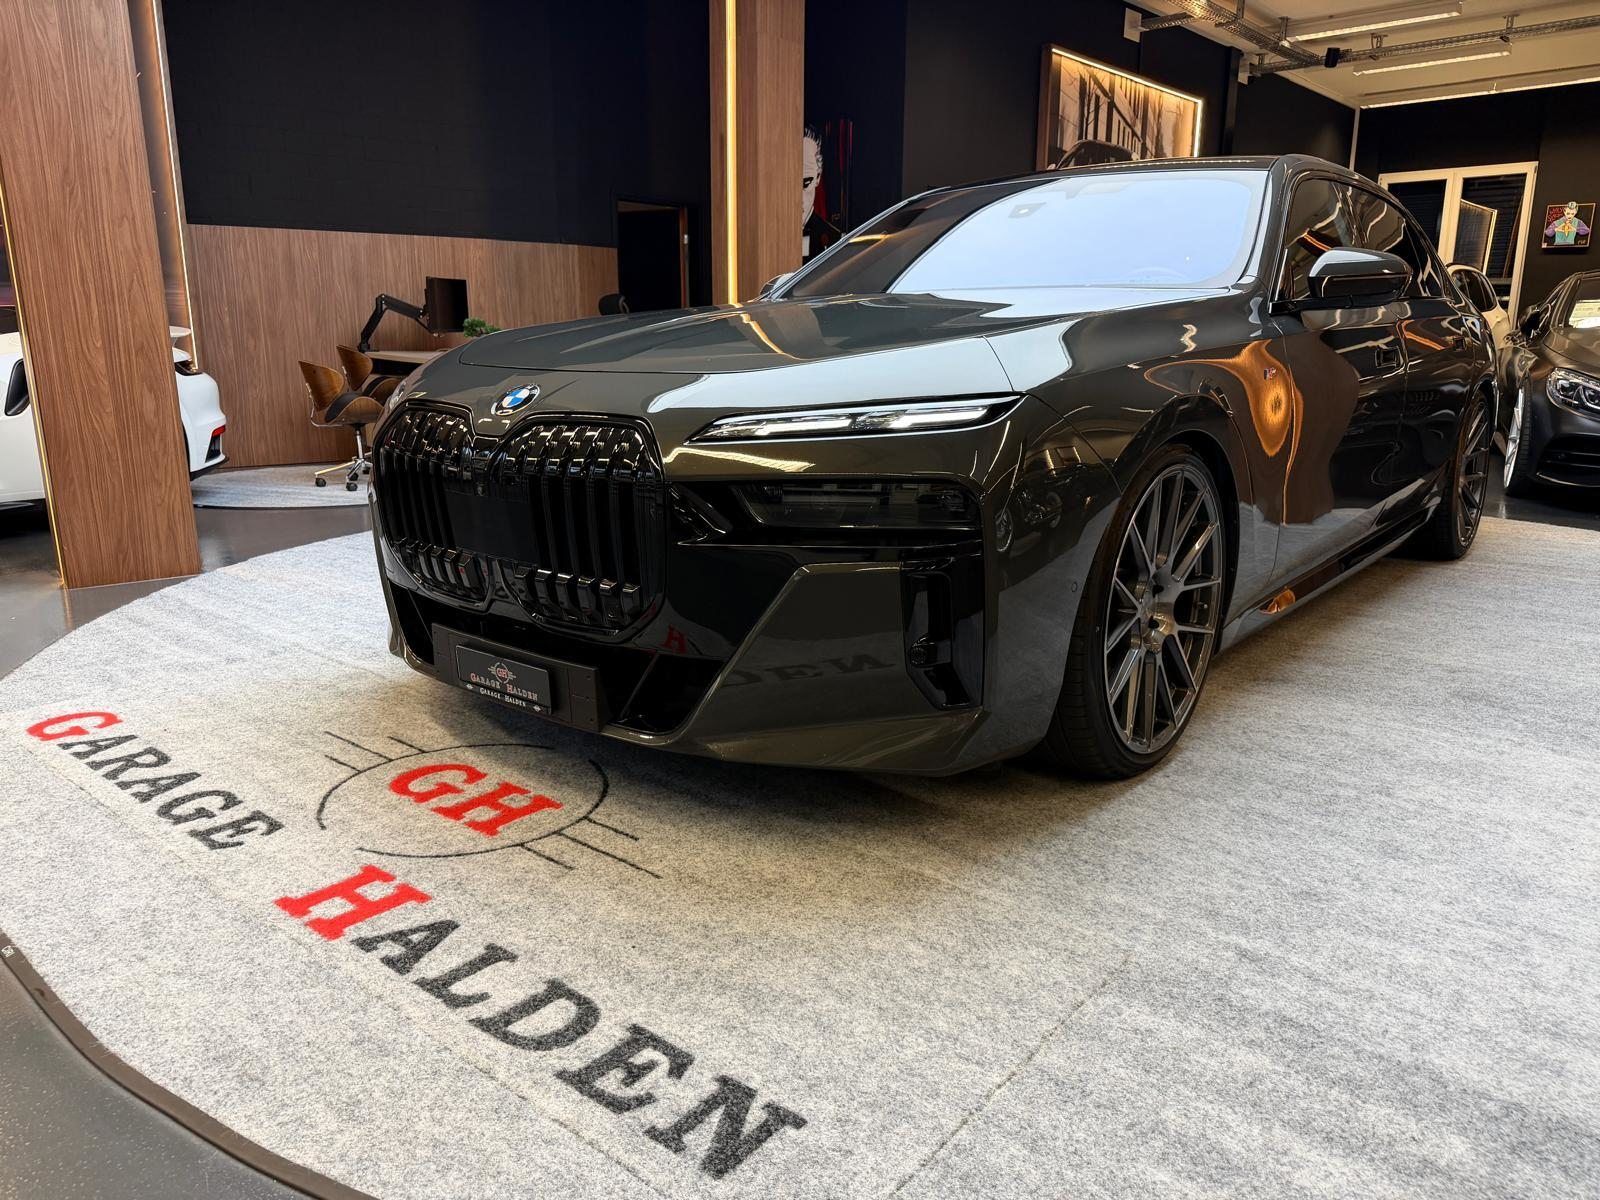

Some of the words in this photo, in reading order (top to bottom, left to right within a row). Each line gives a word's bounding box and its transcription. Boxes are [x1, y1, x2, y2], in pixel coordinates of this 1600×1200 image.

[471, 673, 500, 688] GARAGE
[507, 684, 537, 701] HALDEN
[480, 688, 500, 699] GARAGE
[389, 762, 563, 837] GH
[26, 711, 285, 851] GARAGE
[274, 864, 808, 1180] HALDEN
